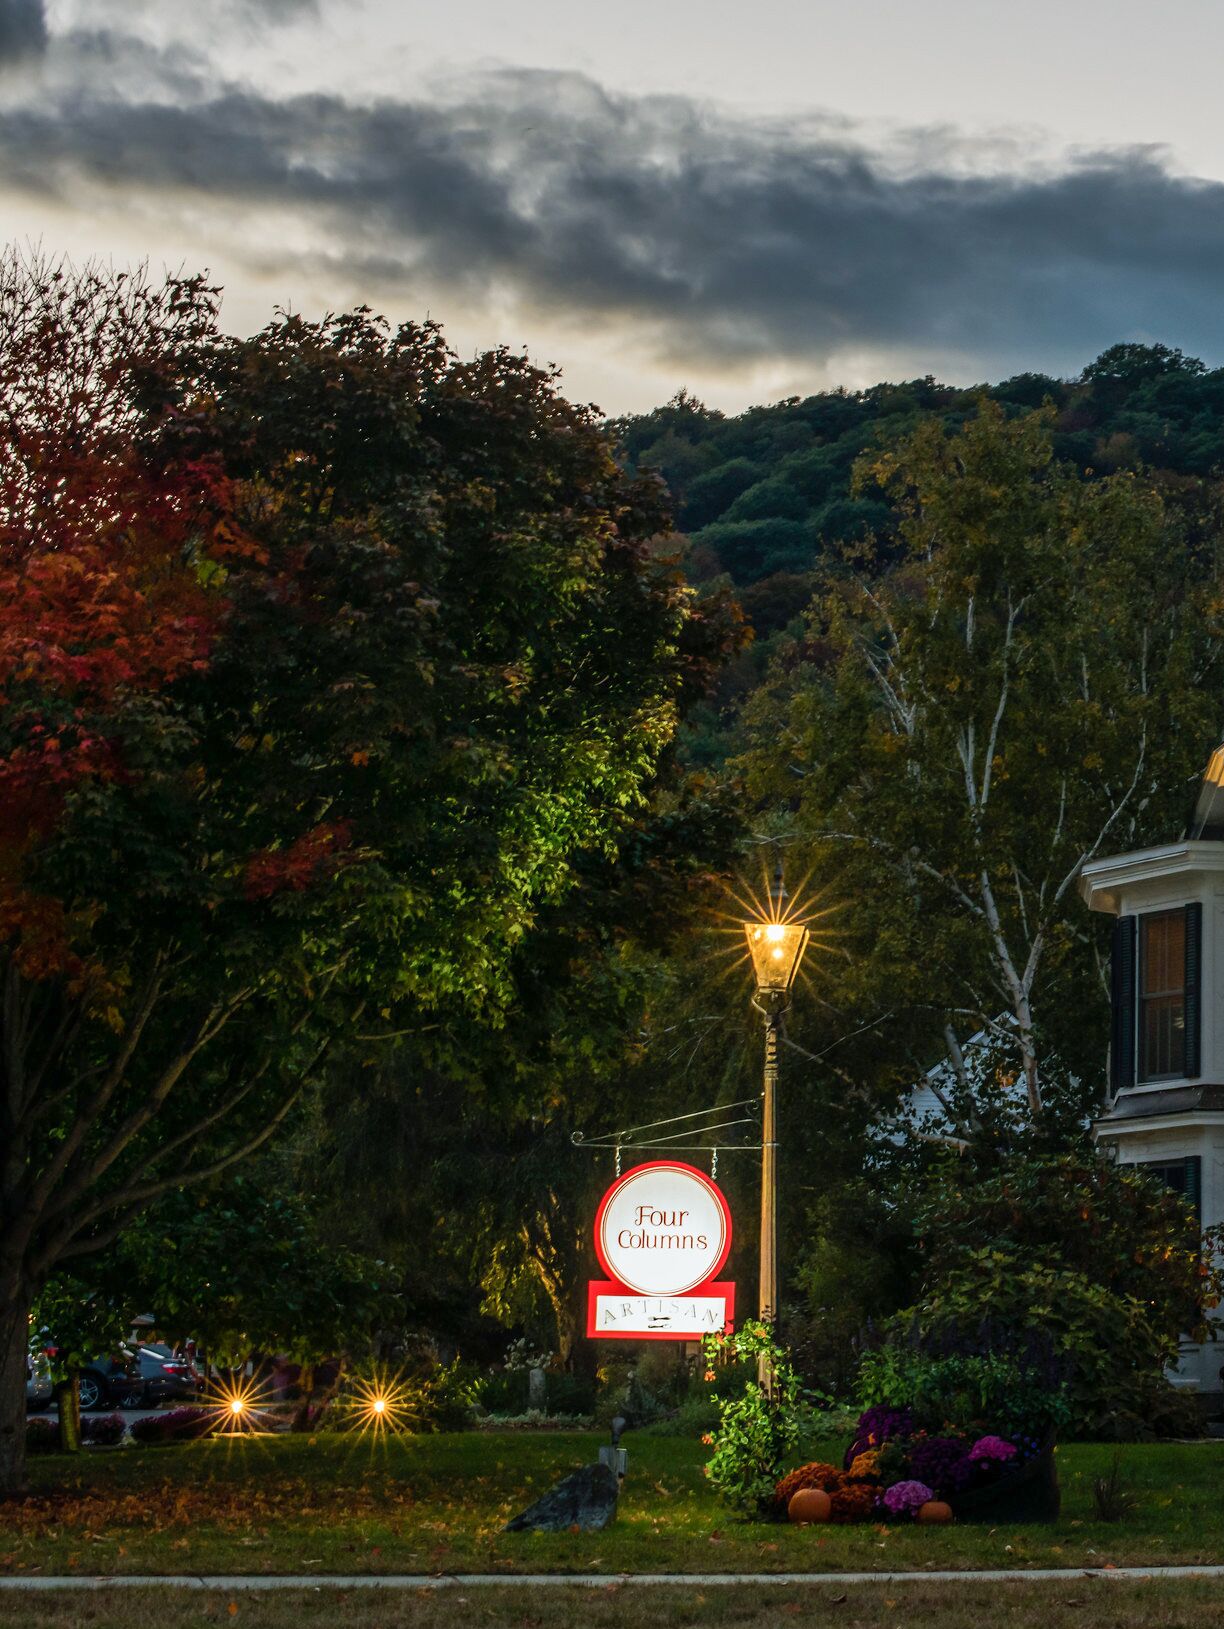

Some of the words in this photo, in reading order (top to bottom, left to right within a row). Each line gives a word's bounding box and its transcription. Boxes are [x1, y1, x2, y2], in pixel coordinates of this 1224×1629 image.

[634, 1205, 690, 1227] Four
[617, 1229, 708, 1250] Columns
[604, 1299, 718, 1324] ARTISAN
